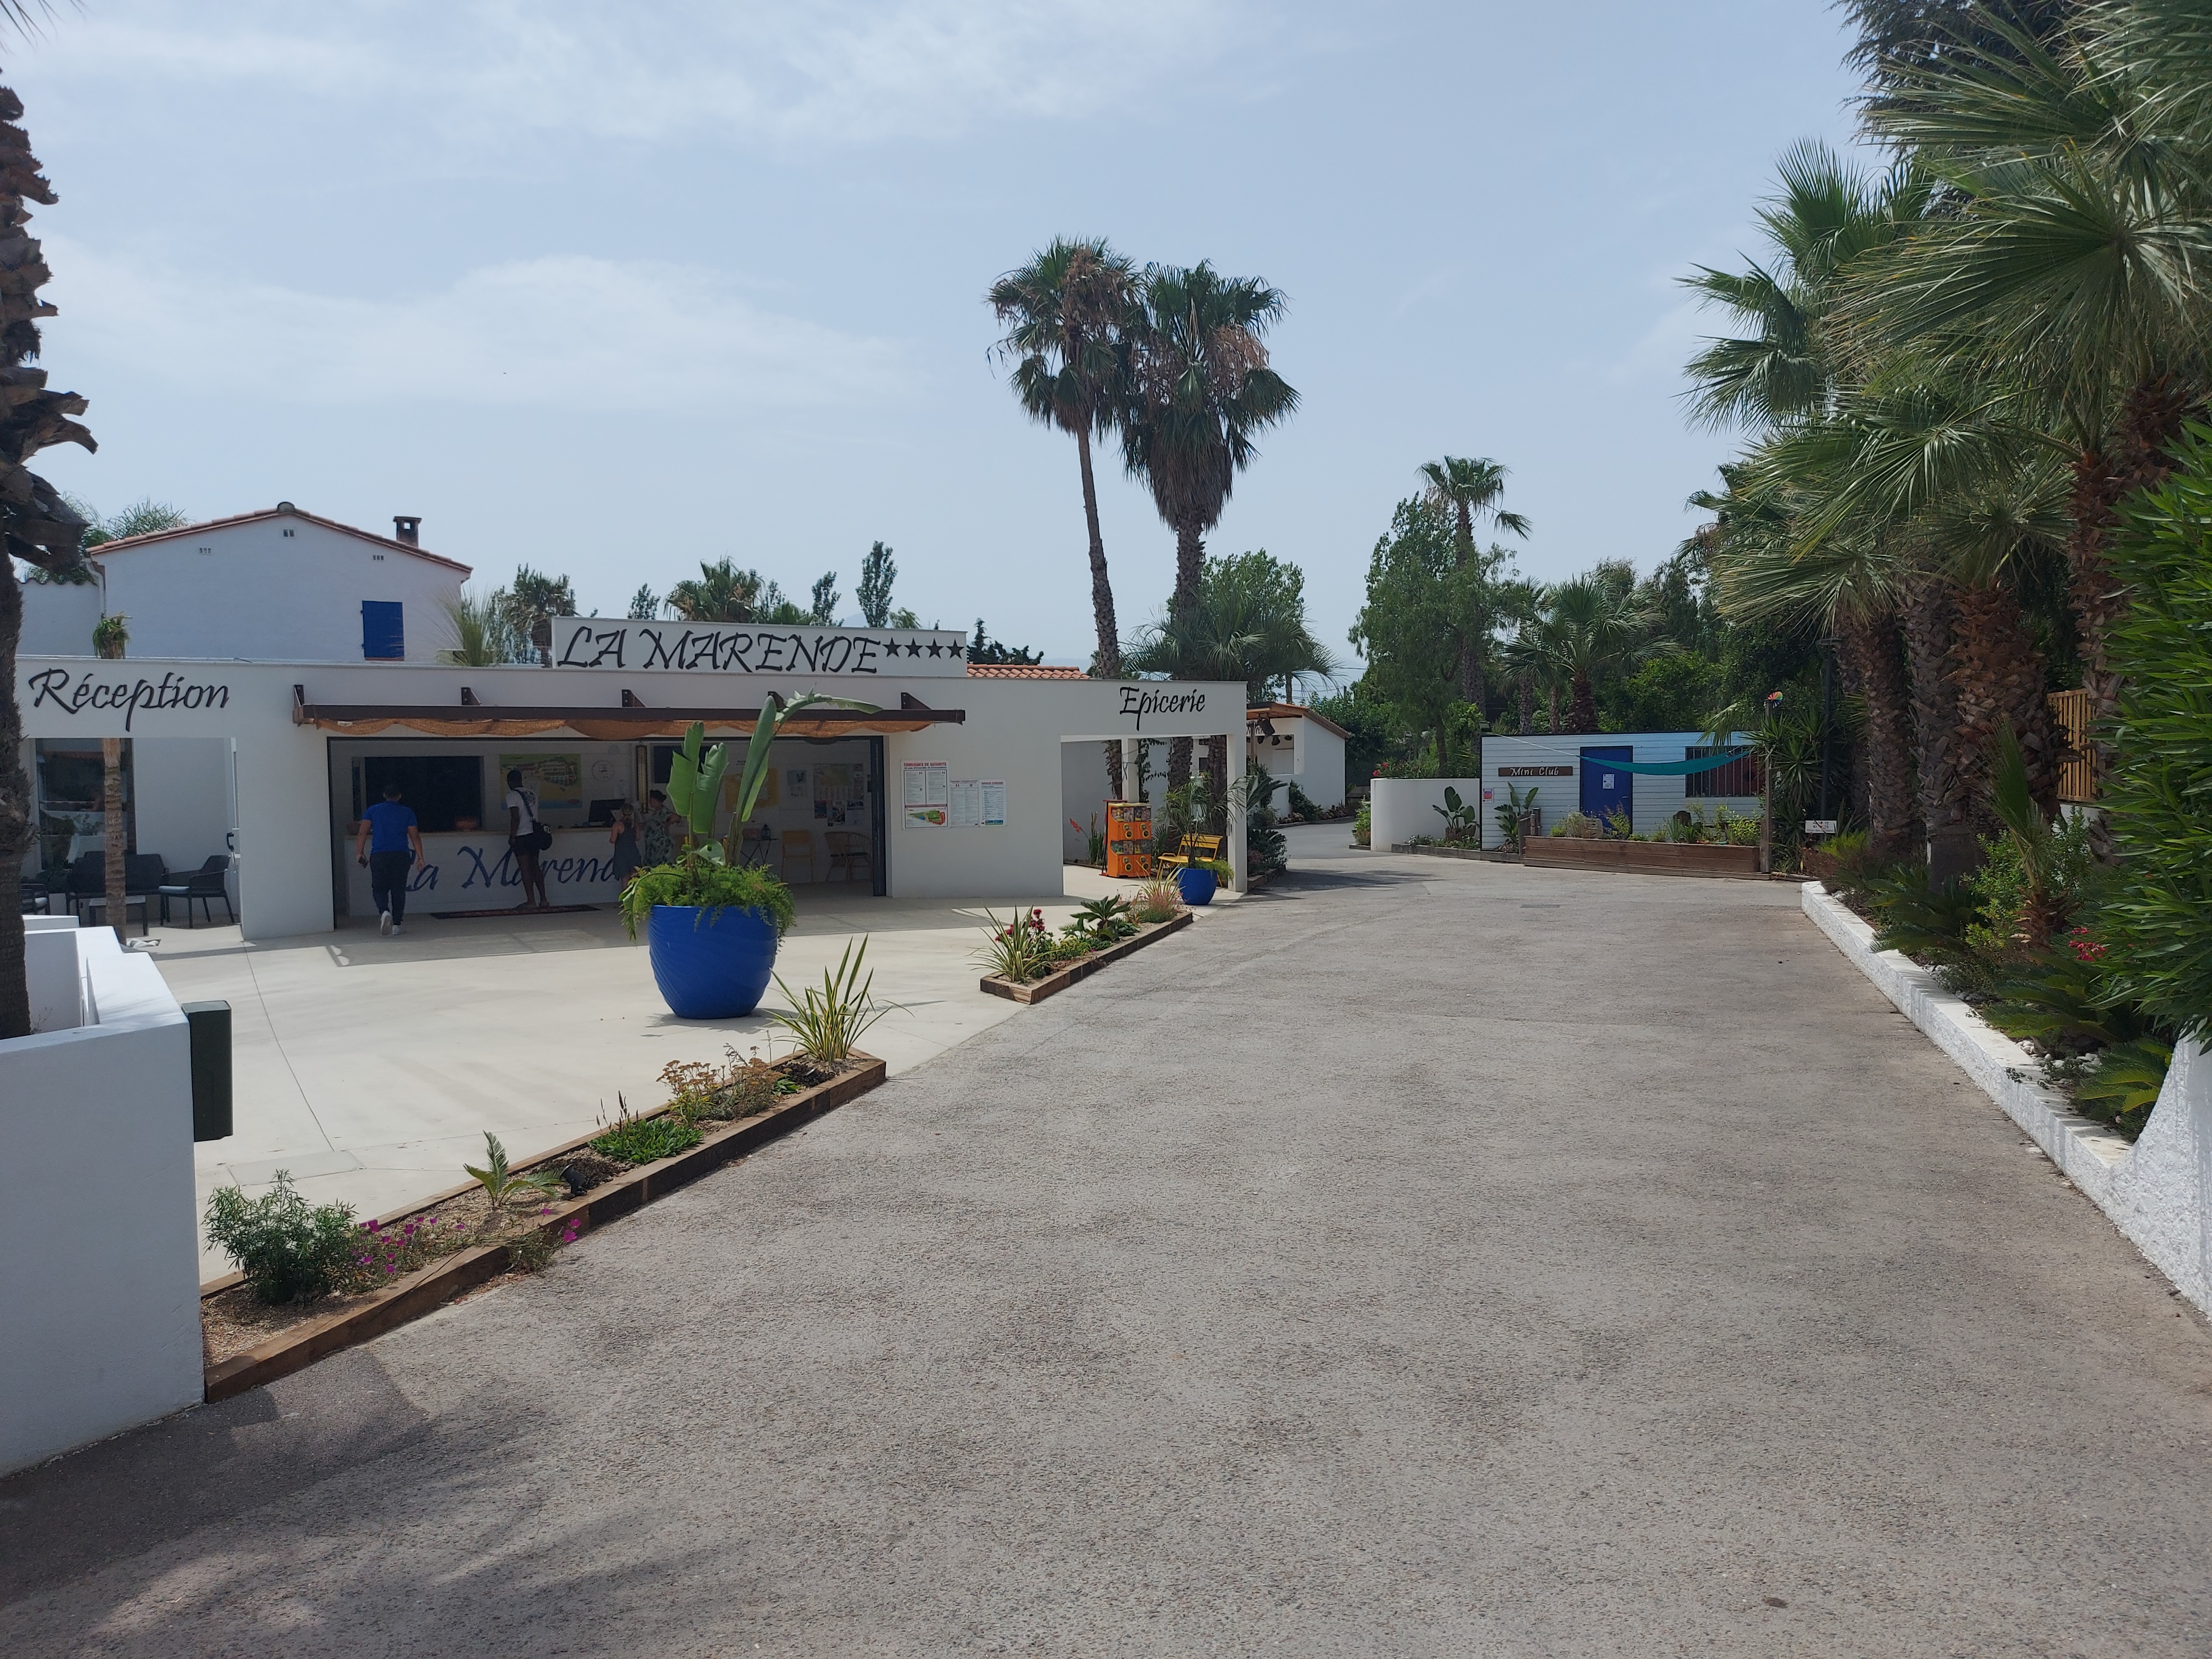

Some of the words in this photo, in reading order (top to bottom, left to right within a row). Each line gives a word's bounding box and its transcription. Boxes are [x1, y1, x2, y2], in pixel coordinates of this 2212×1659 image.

[557, 626, 628, 668] LA
[639, 629, 881, 674] MARENDE
[28, 668, 230, 732] Réception
[1119, 686, 1206, 731] Epicerie
[1510, 767, 1533, 776] Mini
[1539, 767, 1559, 775] Club
